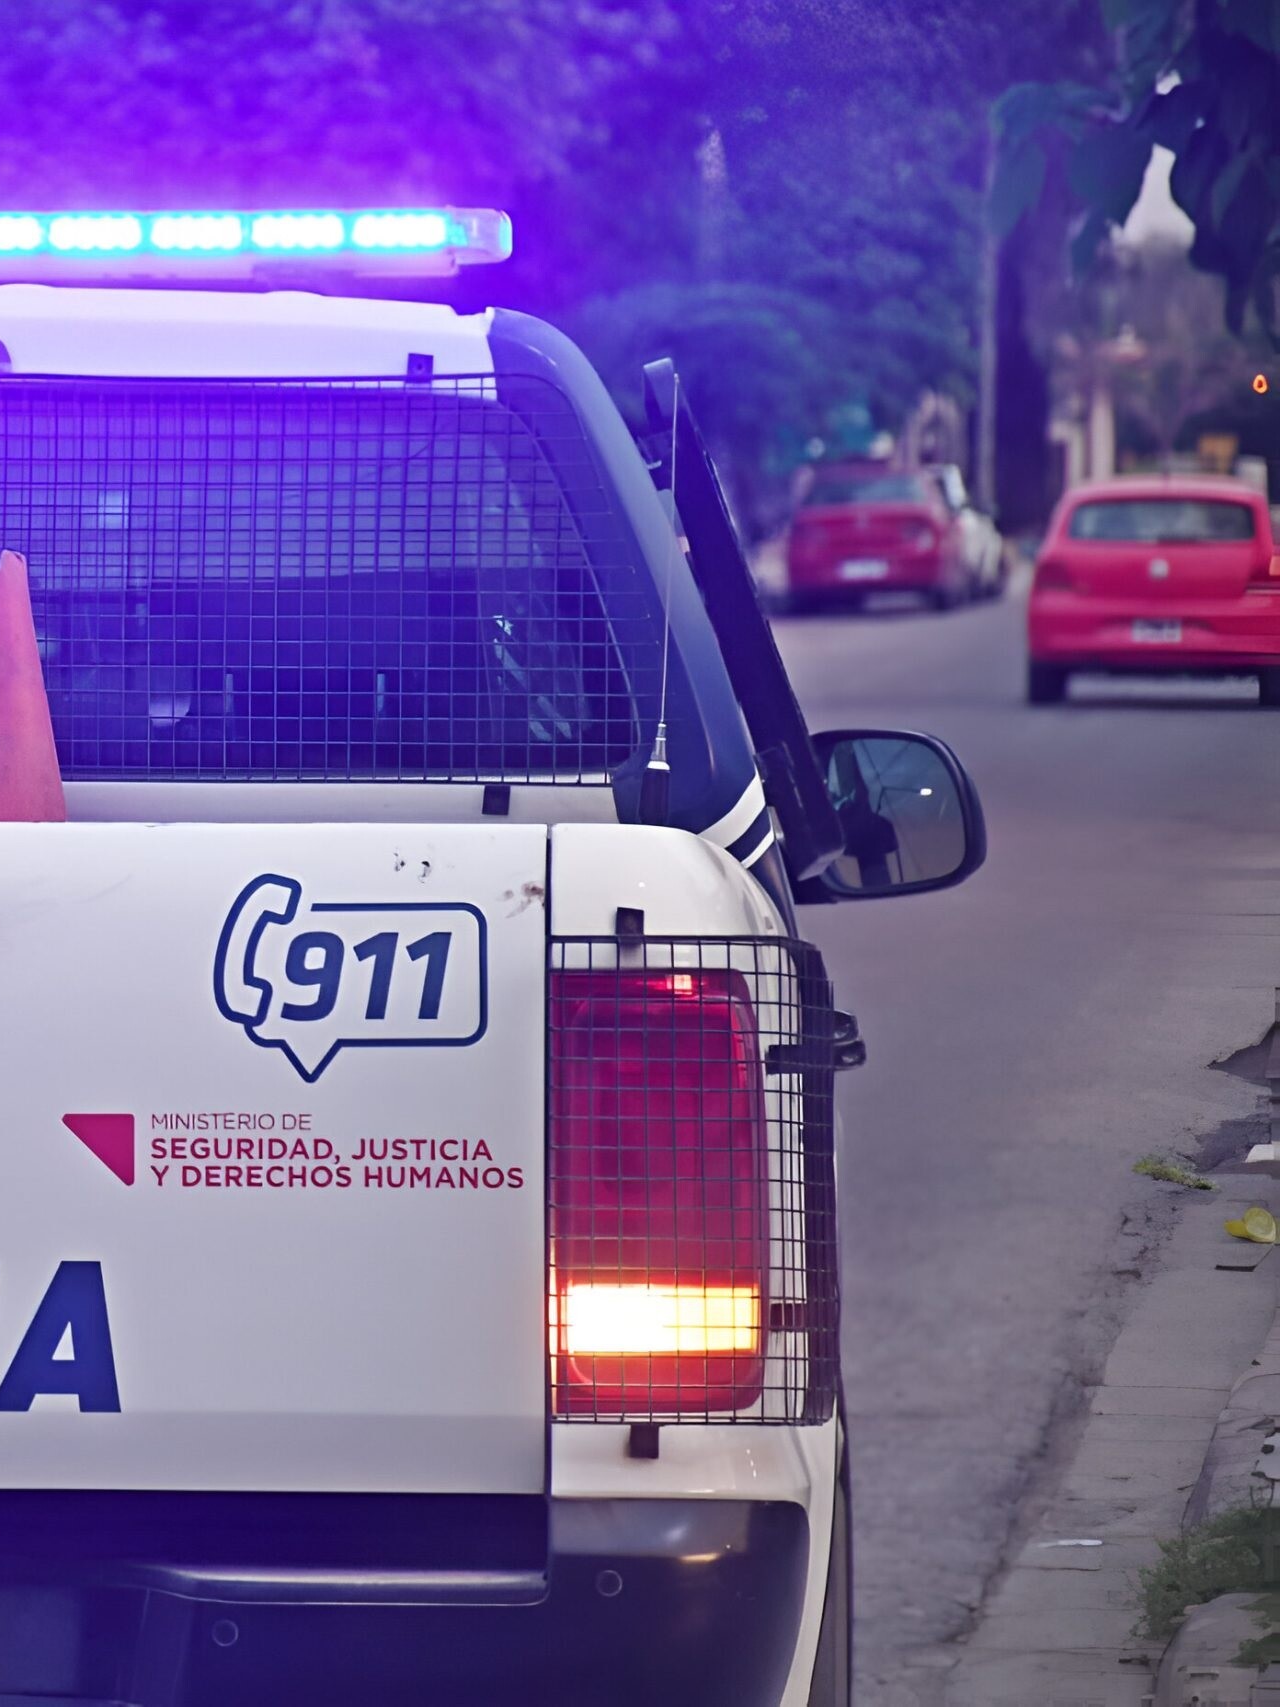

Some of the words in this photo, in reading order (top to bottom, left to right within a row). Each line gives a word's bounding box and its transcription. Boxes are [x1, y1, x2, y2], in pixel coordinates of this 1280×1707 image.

[279, 930, 453, 1022] 911
[151, 1112, 276, 1131] MINISTERIO
[281, 1113, 313, 1131] DE
[150, 1137, 341, 1165] SEGURIDAD,
[351, 1138, 494, 1162] JUSTICIA
[150, 1165, 170, 1187] Y
[181, 1164, 353, 1189] DERECHOS
[363, 1165, 525, 1190] HUMANOS
